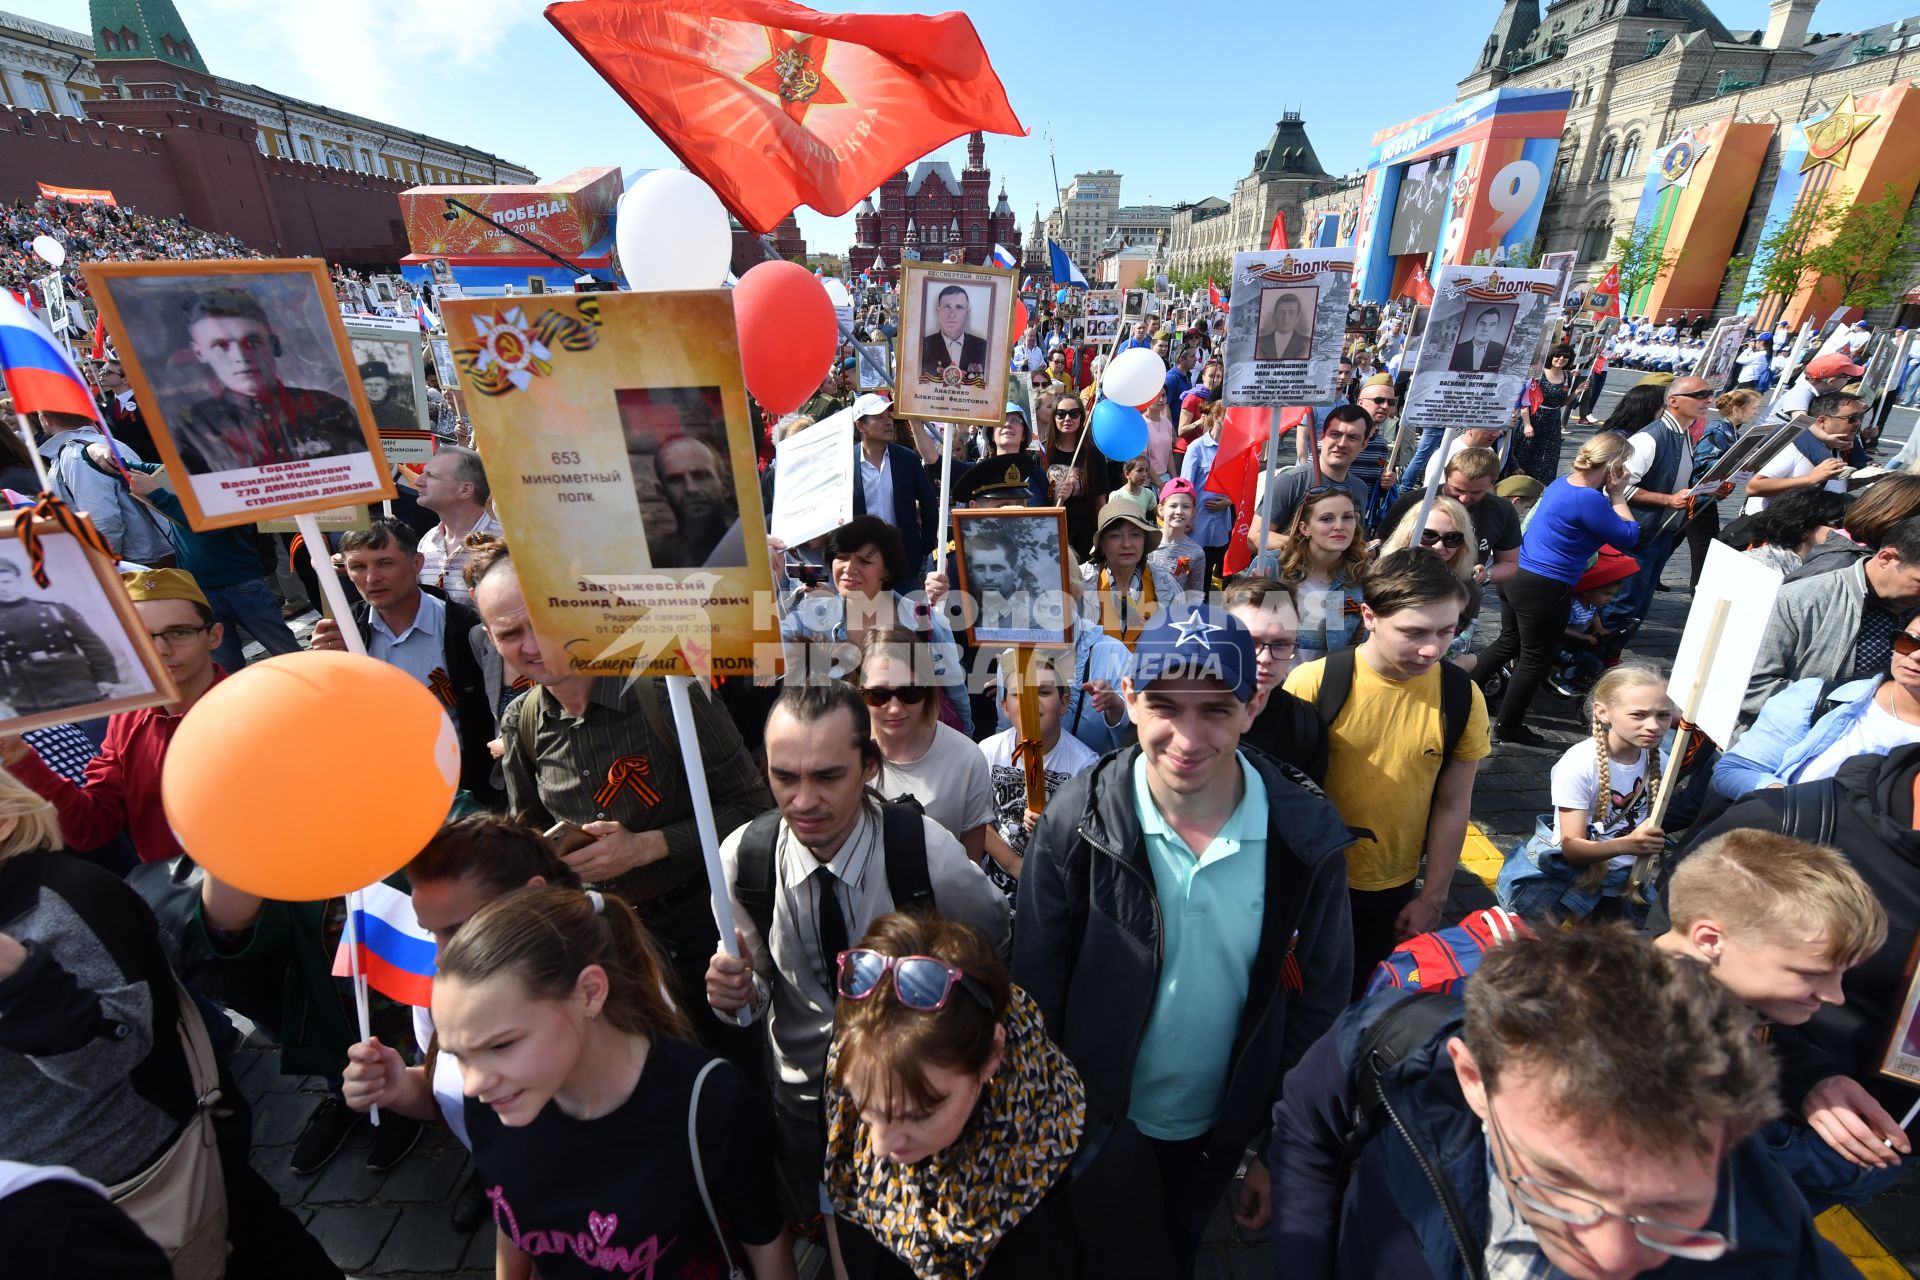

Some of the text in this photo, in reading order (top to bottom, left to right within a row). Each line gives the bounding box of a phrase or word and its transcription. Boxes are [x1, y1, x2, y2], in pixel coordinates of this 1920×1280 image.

[804, 107, 879, 162] МОСКВА
[1488, 160, 1541, 236] 9
[492, 199, 568, 224] ПОБЕДА!
[513, 222, 536, 234] 2018
[1293, 260, 1329, 274] ПОЛК
[1497, 281, 1533, 293] ПОЛК
[914, 393, 989, 405] Алексей Федотович
[552, 452, 581, 465] 653
[258, 461, 310, 474] Гордин
[220, 465, 352, 490] Василий Иванович
[521, 470, 622, 485] минометный
[236, 488, 260, 497] 270
[245, 480, 374, 507] стрелковая дивизия
[558, 491, 595, 503] полк
[577, 579, 706, 593] Закрыжевский
[548, 597, 750, 609] Леонид Аппалинарович
[603, 613, 697, 623] Рядовой связист
